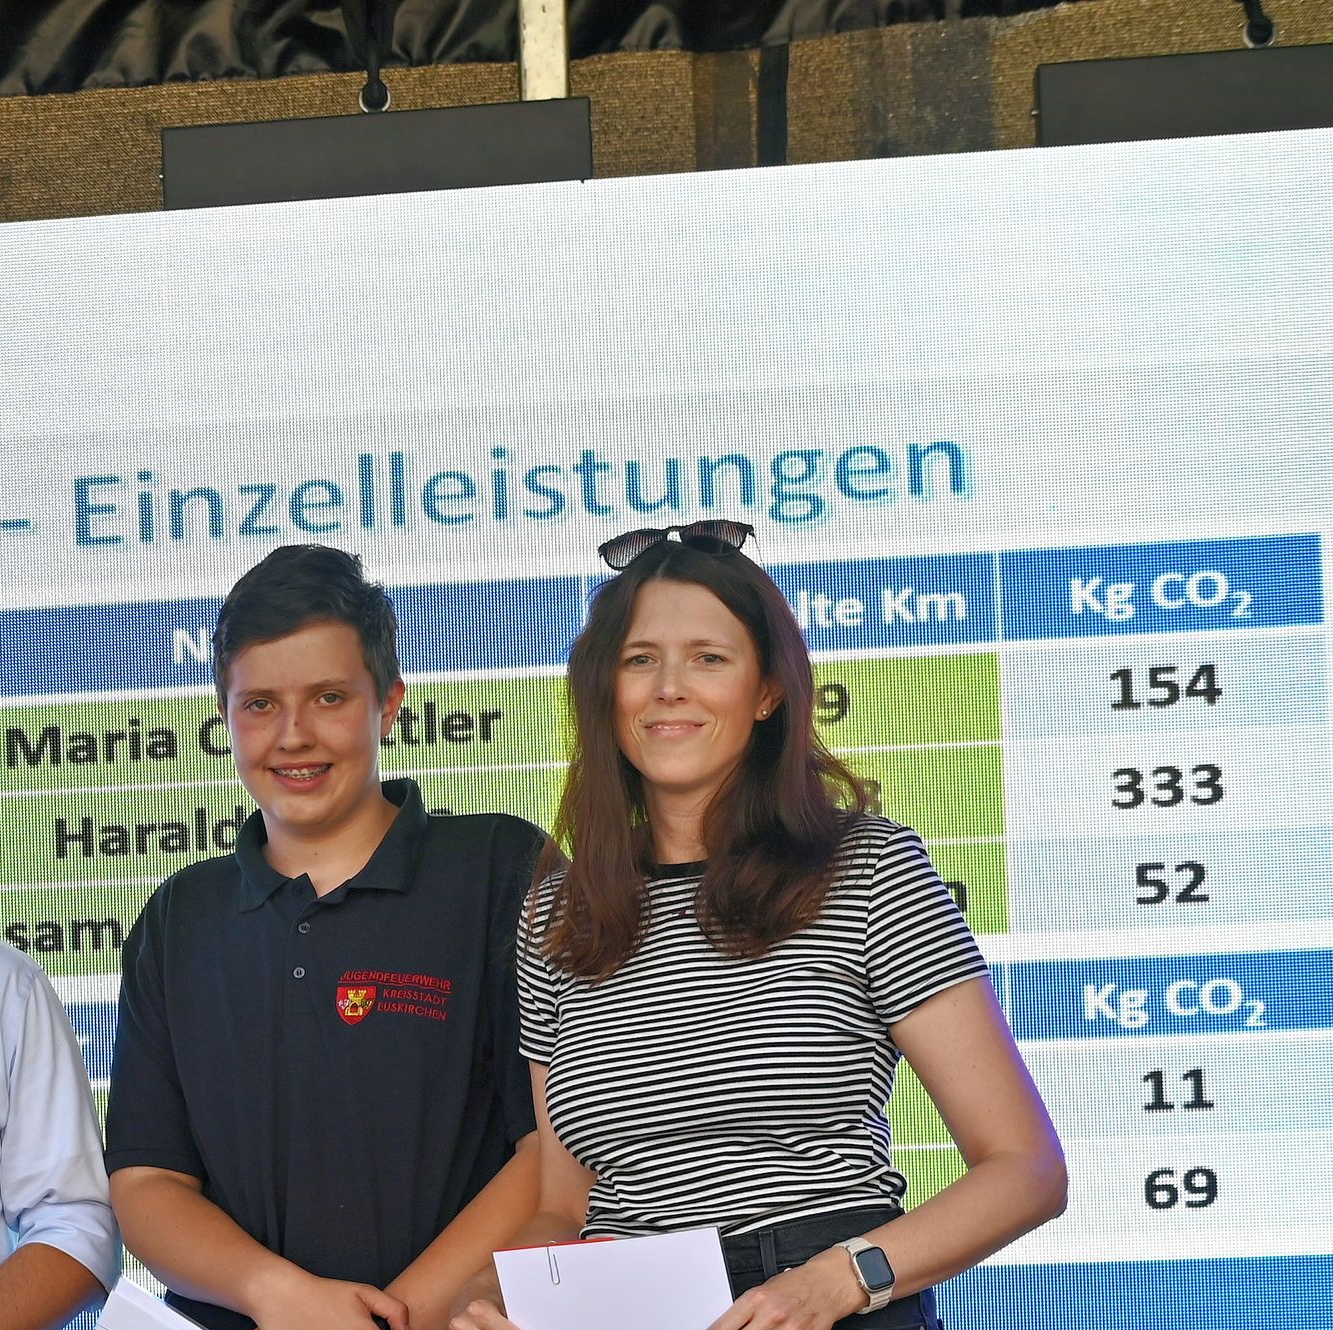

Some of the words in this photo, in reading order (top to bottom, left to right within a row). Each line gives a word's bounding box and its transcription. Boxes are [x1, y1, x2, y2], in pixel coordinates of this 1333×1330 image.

[0, 518, 32, 531] -
[73, 440, 969, 548] Einzelleistungen
[884, 587, 966, 624] Km
[1070, 577, 1135, 619] Kg
[1108, 661, 1222, 712] 154
[6, 717, 178, 769] Maria
[380, 700, 504, 747] tler
[1111, 763, 1225, 808] 333
[1135, 862, 1211, 906] 52
[340, 970, 451, 991] JUGENDFEUERWEHR
[383, 988, 448, 1006] KREISSTADT
[377, 1002, 447, 1021] EUSKIRCHEN
[1084, 984, 1148, 1028] Kg
[1143, 1068, 1214, 1113] 11
[1144, 1166, 1219, 1210] 69
